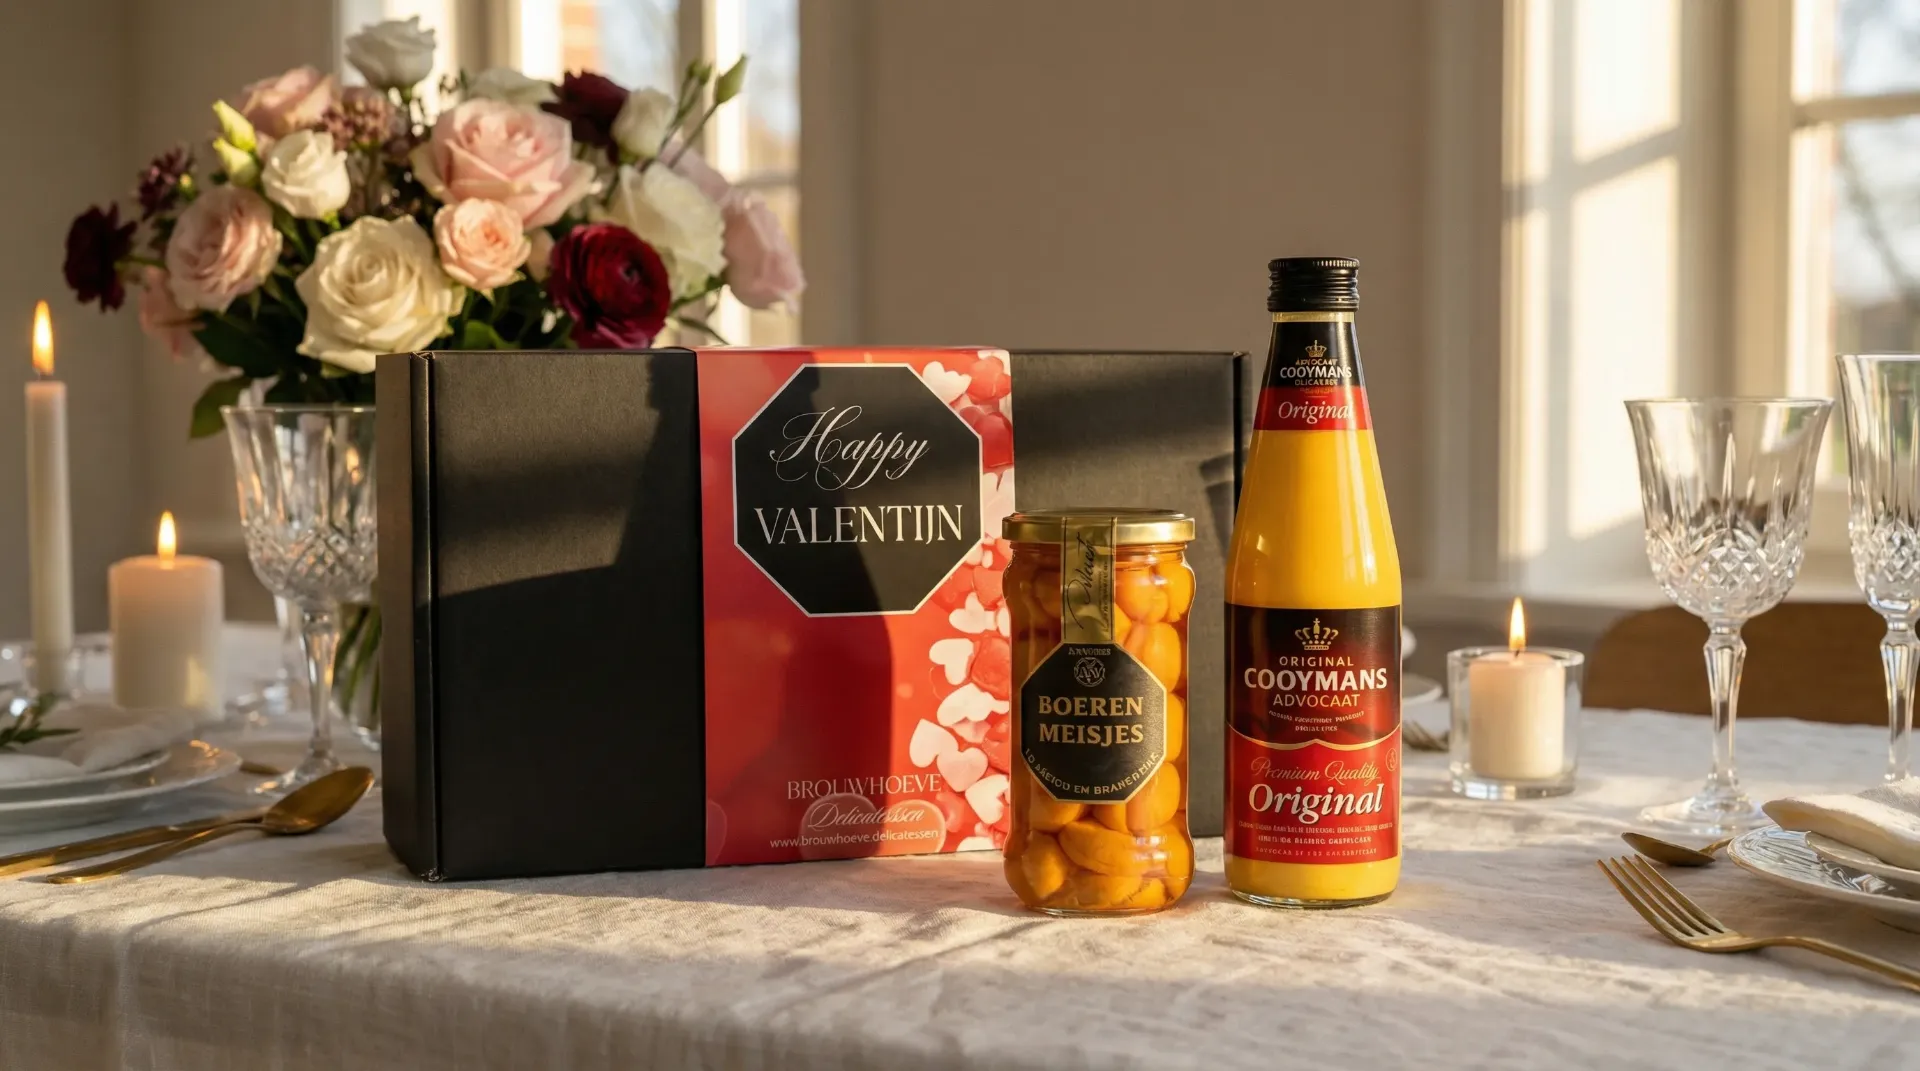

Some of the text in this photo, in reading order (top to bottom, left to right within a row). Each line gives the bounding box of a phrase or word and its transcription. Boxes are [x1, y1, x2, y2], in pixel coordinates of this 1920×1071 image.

[1280, 366, 1352, 378] COOYMANS
[769, 405, 930, 491] Happy
[753, 504, 963, 545] VALENTIJN
[1279, 656, 1354, 667] ORIGINAL
[1244, 668, 1388, 692] COOYMANS
[1038, 695, 1144, 717] BOEREN
[1273, 694, 1361, 708] ADVOCAAT
[1038, 723, 1144, 747] MEISJES
[1250, 756, 1381, 787] Premium Quality
[787, 773, 942, 800] BROUWHOEVE
[1248, 783, 1385, 825] Original
[807, 802, 926, 832] Delicatessen
[770, 829, 940, 849] www.brouwhoeve.delicatessen
